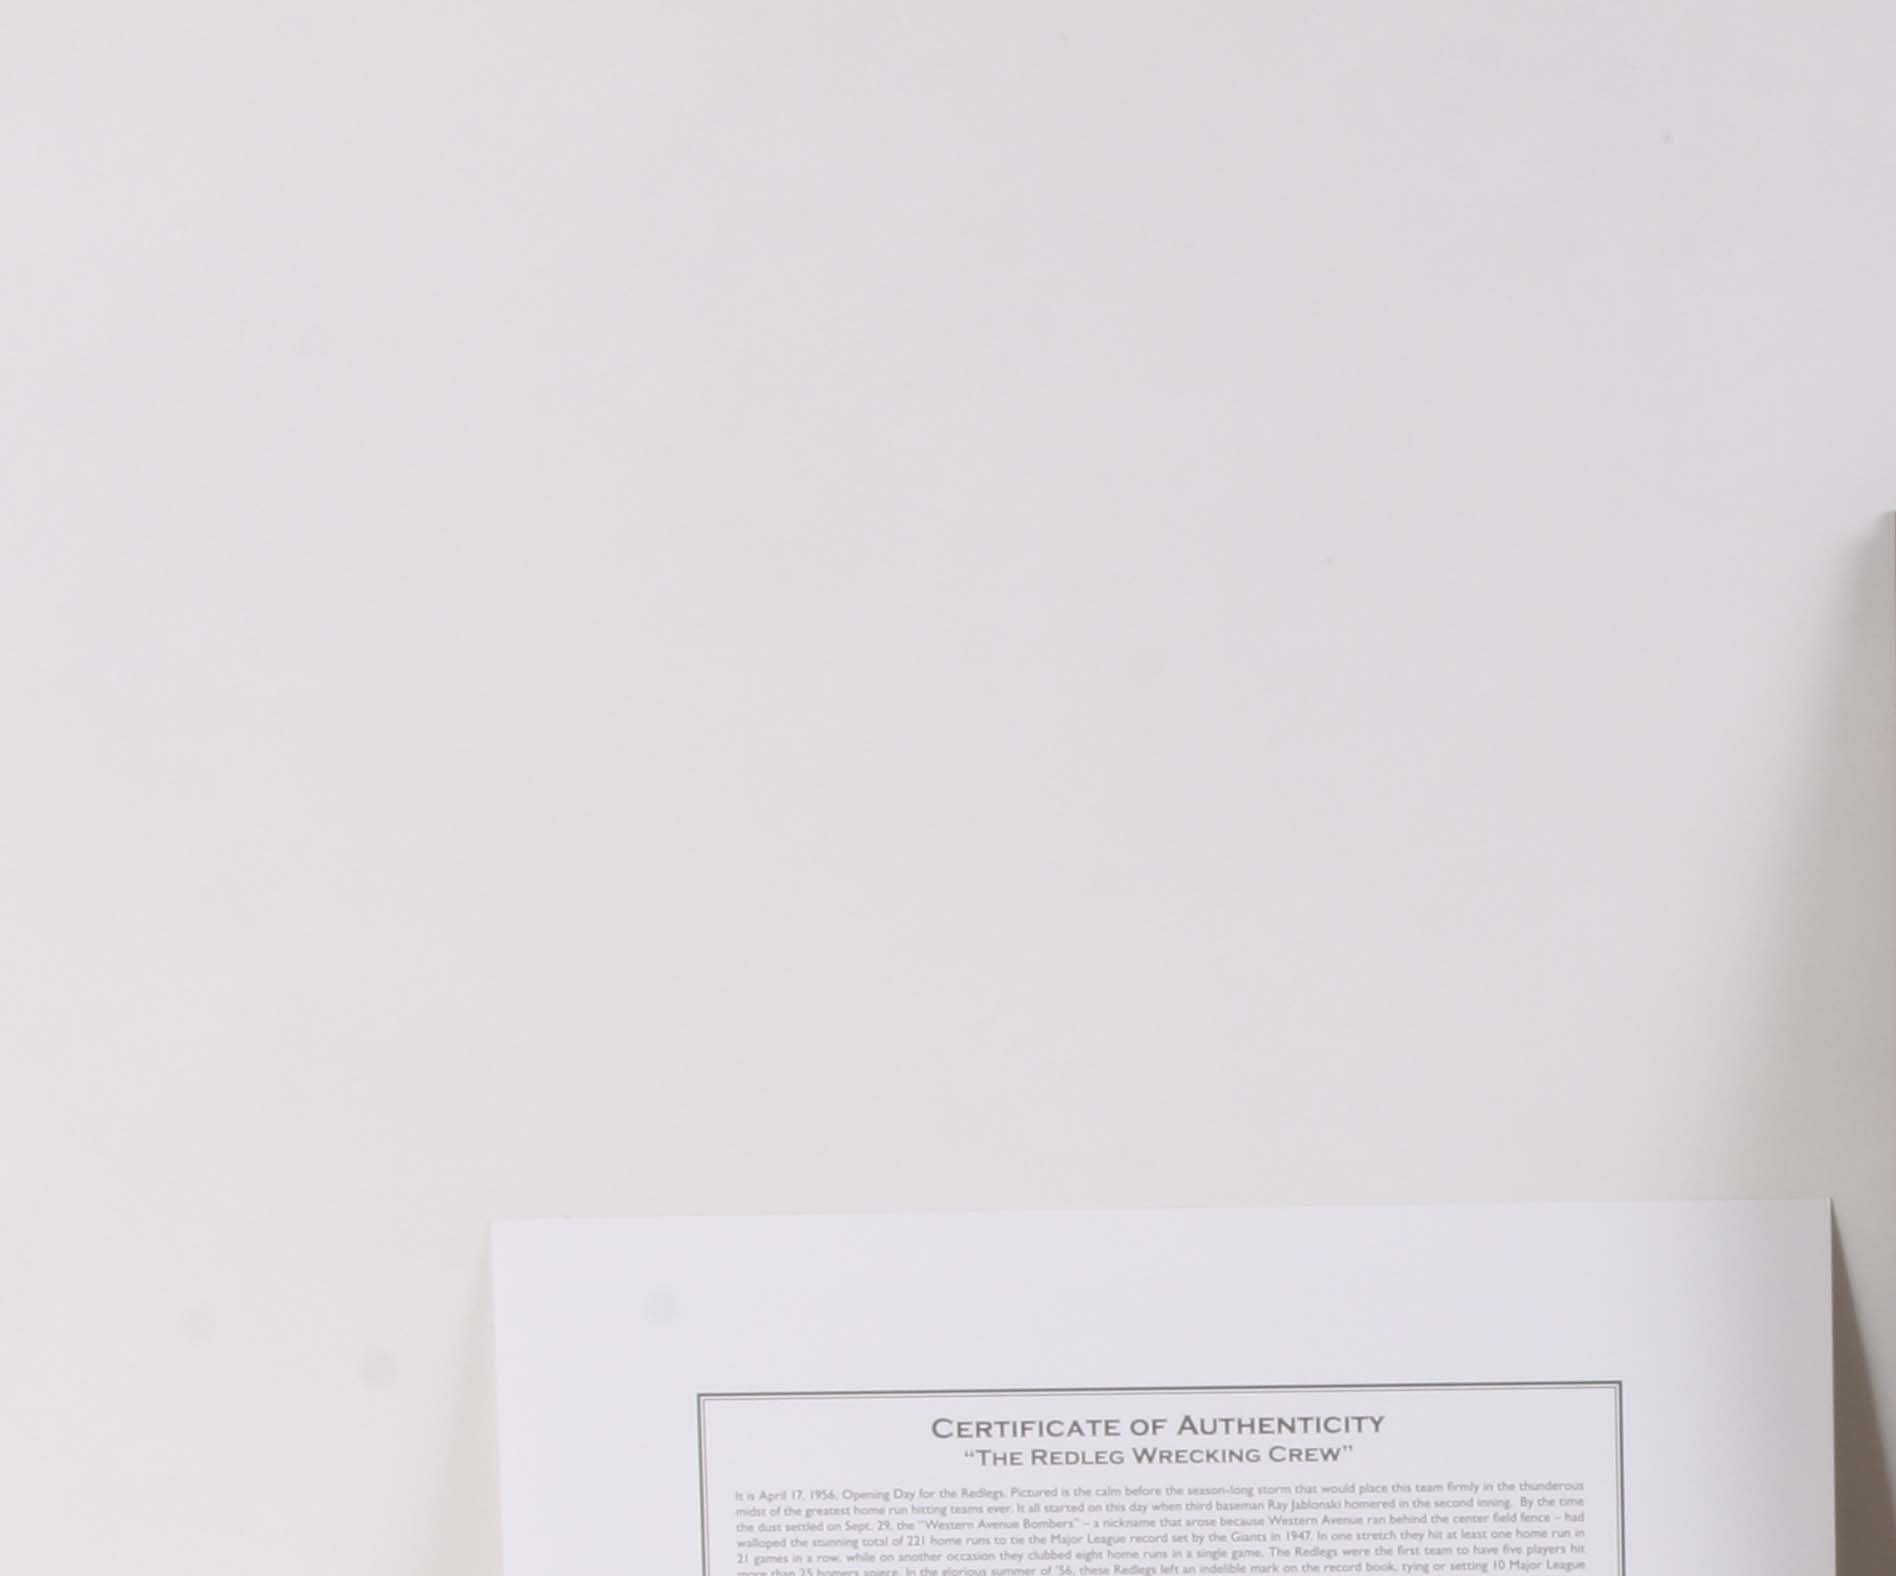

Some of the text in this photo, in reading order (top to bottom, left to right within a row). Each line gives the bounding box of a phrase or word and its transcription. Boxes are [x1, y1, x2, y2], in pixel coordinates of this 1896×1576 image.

[931, 1415, 1386, 1438] CERTIFICATE OF AUTHENTICITY
[1030, 1448, 1125, 1466] REDLEG
[1131, 1446, 1261, 1465] WRECKING
[735, 1491, 743, 1501] It
[746, 1493, 755, 1501] is
[759, 1490, 786, 1502] April
[841, 1488, 890, 1502] Opening
[893, 1487, 915, 1501] Day
[918, 1488, 935, 1499] for
[938, 1487, 957, 1498] the
[1010, 1486, 1058, 1498] Pictured
[1061, 1489, 1070, 1497] is
[1073, 1486, 1092, 1497] the
[1095, 1486, 1122, 1497] calm
[1124, 1485, 1161, 1496] before
[1165, 1486, 1183, 1496] the
[1187, 1486, 1254, 1498] season-long
[1257, 1486, 1292, 1495] storm
[1294, 1484, 1317, 1494] that
[1321, 1483, 1356, 1494] would
[1358, 1483, 1388, 1496] place
[1391, 1483, 1412, 1493] this
[1415, 1483, 1444, 1493] team
[1447, 1480, 1479, 1494] firmly
[1483, 1483, 1494, 1491] in
[1496, 1480, 1516, 1491] the
[1518, 1480, 1584, 1491] thunderous
